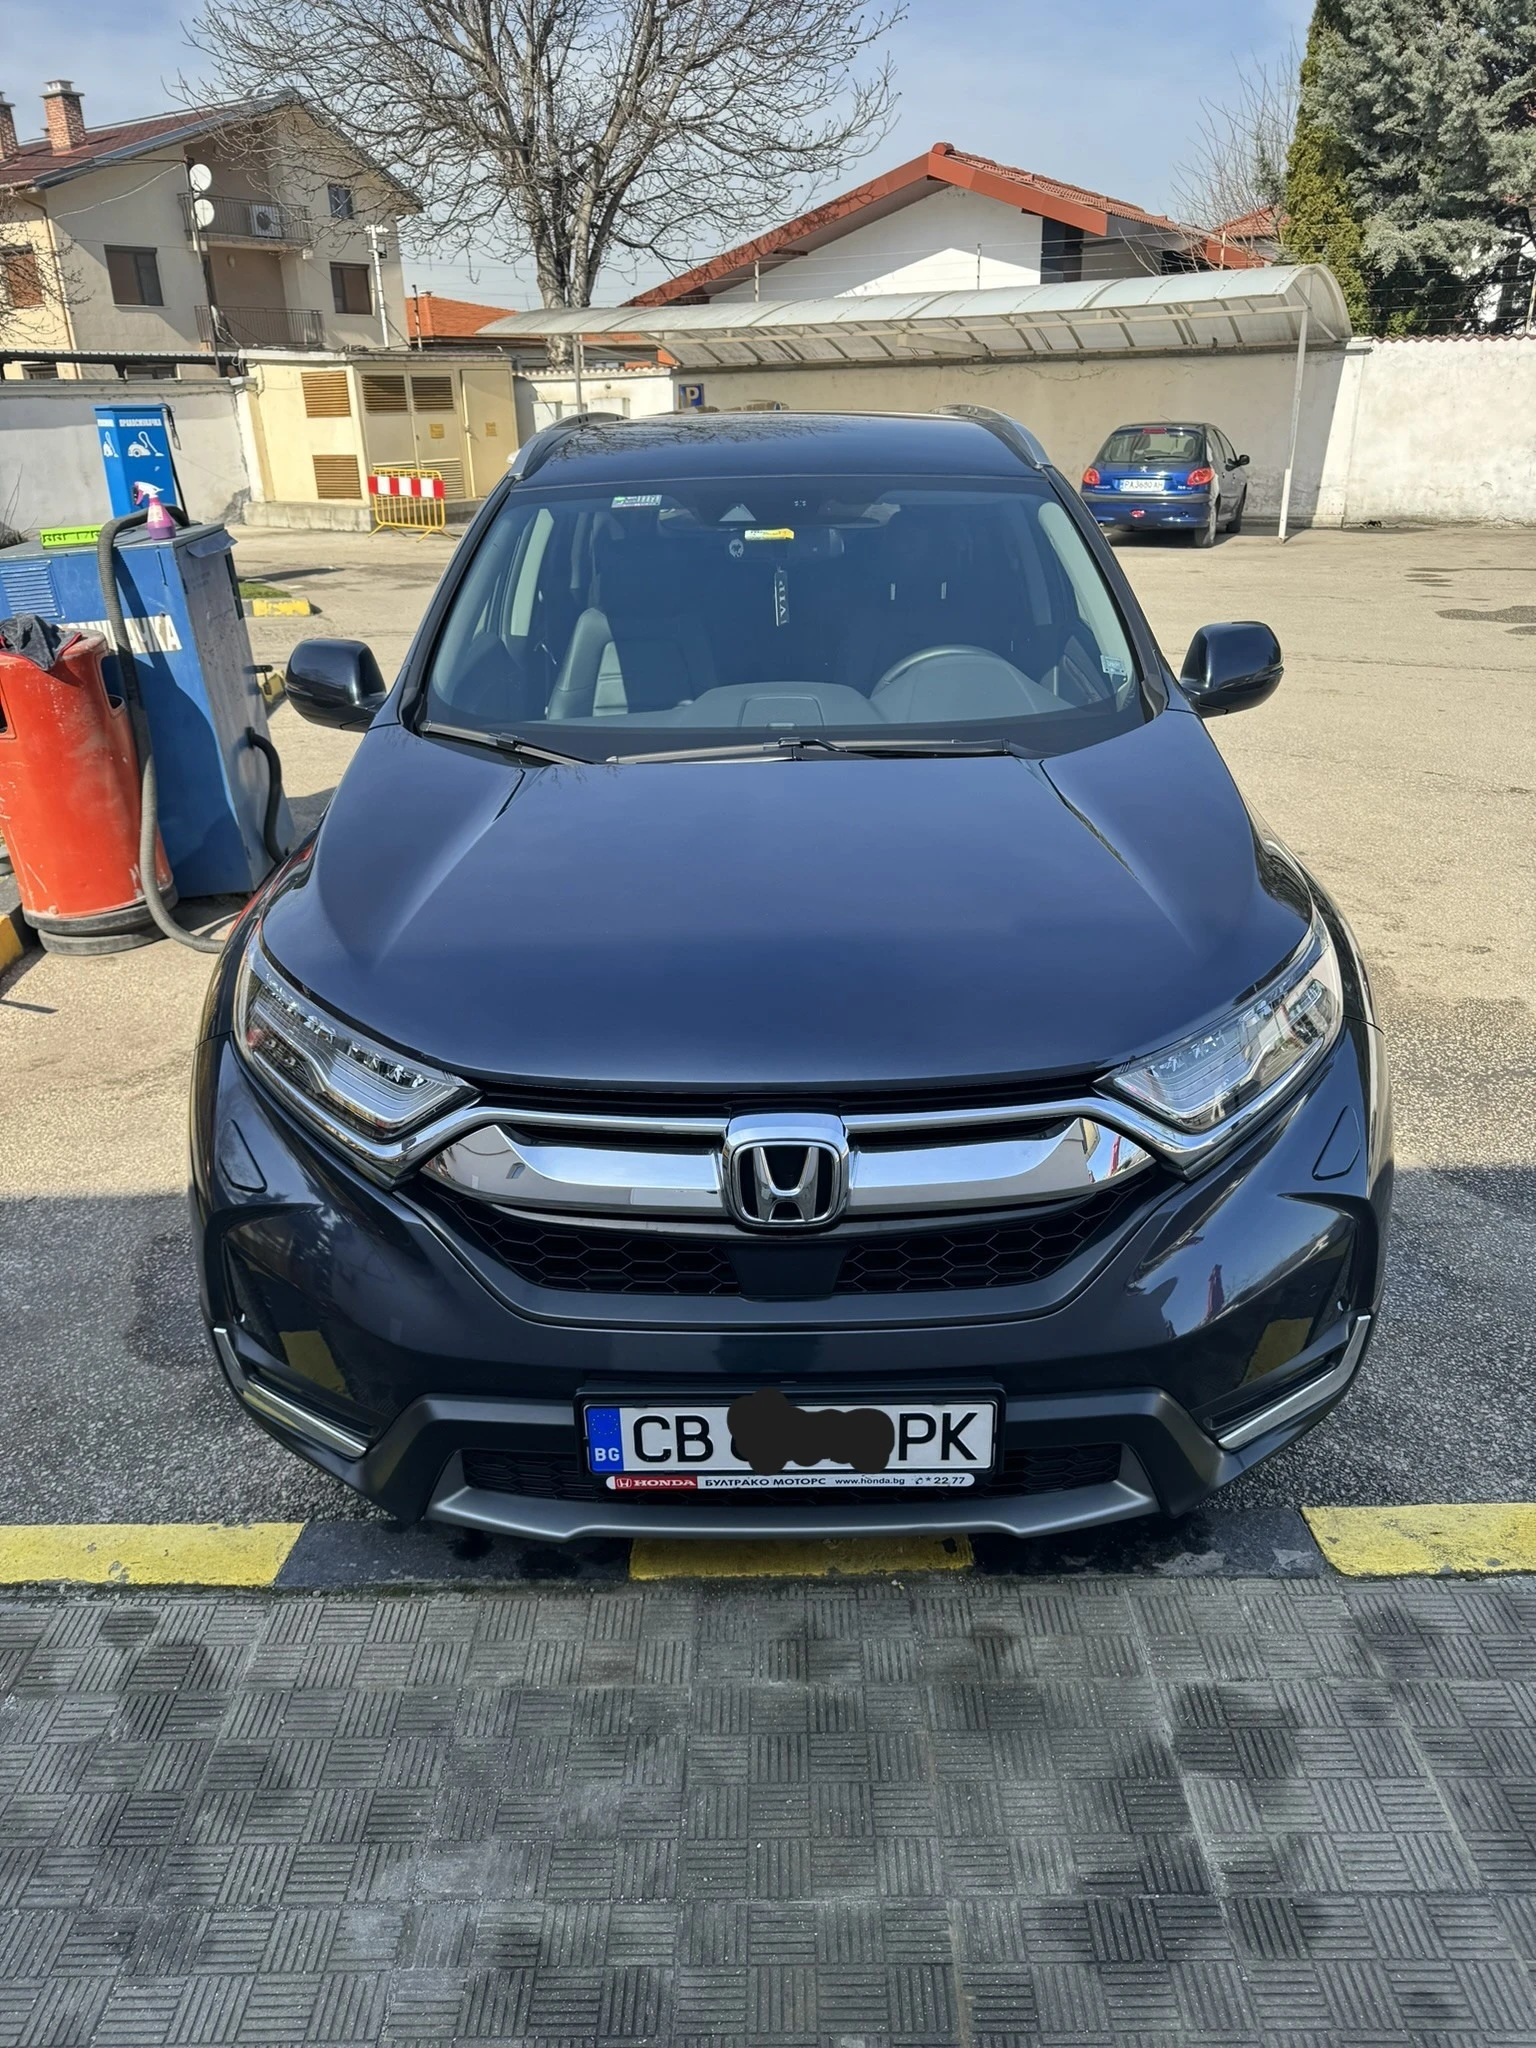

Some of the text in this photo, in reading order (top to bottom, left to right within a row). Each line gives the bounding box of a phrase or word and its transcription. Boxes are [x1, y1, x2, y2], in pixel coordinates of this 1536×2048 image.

[686, 387, 699, 408] P
[633, 1415, 714, 1463] CB
[898, 1412, 978, 1461] PK
[594, 1447, 620, 1462] BG
[634, 1479, 696, 1488] HONDA
[705, 1477, 826, 1487] БУЛТРАКО МОТОРС
[835, 1477, 905, 1486] www.honda.bg
